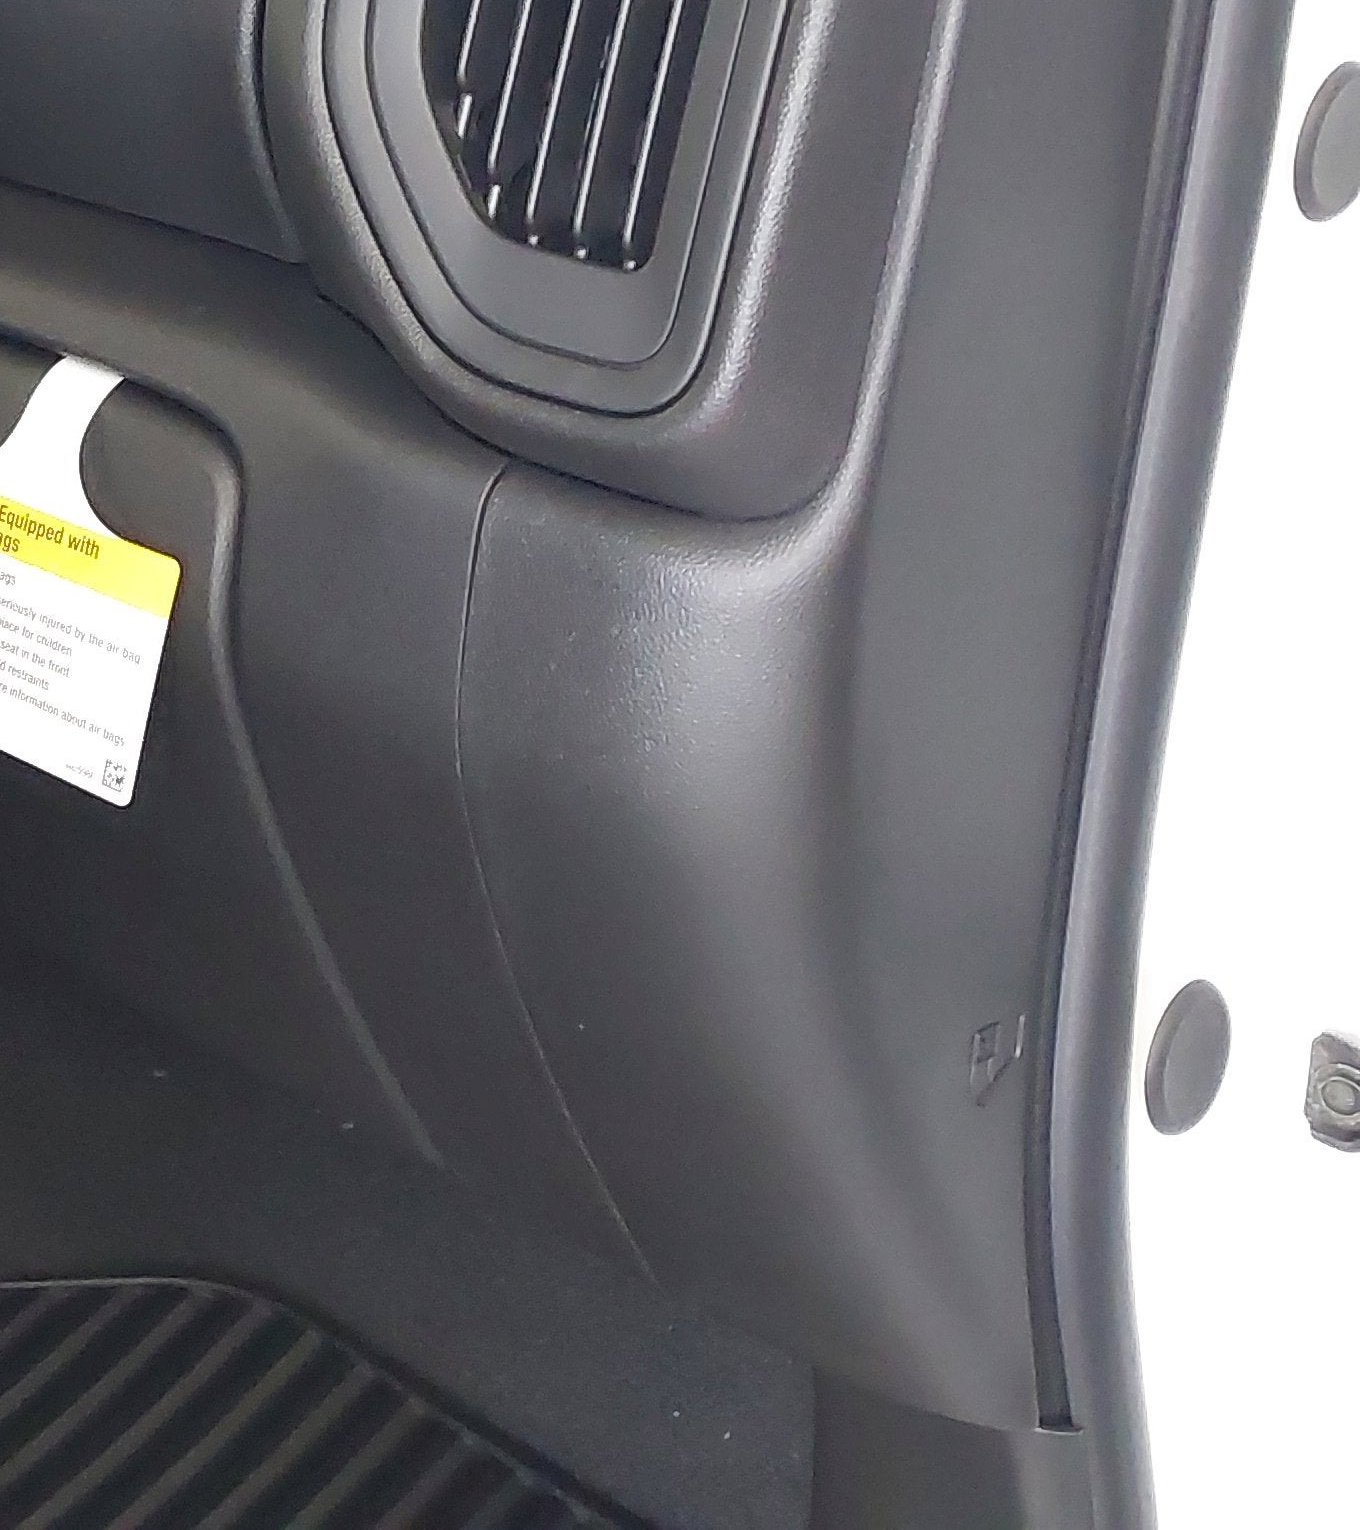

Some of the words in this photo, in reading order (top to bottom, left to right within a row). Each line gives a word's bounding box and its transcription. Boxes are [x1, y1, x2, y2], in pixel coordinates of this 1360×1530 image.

[67, 533, 99, 559] with
[21, 625, 34, 639] for
[36, 634, 72, 656] children
[39, 613, 72, 634] injured
[74, 626, 85, 642] by
[88, 633, 103, 647] the
[106, 642, 119, 653] air
[0, 640, 19, 655] seat
[21, 649, 29, 659] in
[31, 652, 45, 667] the
[48, 659, 69, 677] front
[7, 665, 49, 690] restraints
[9, 687, 58, 716] information
[60, 710, 86, 729] about
[88, 723, 101, 734] air
[102, 728, 124, 746] bags
